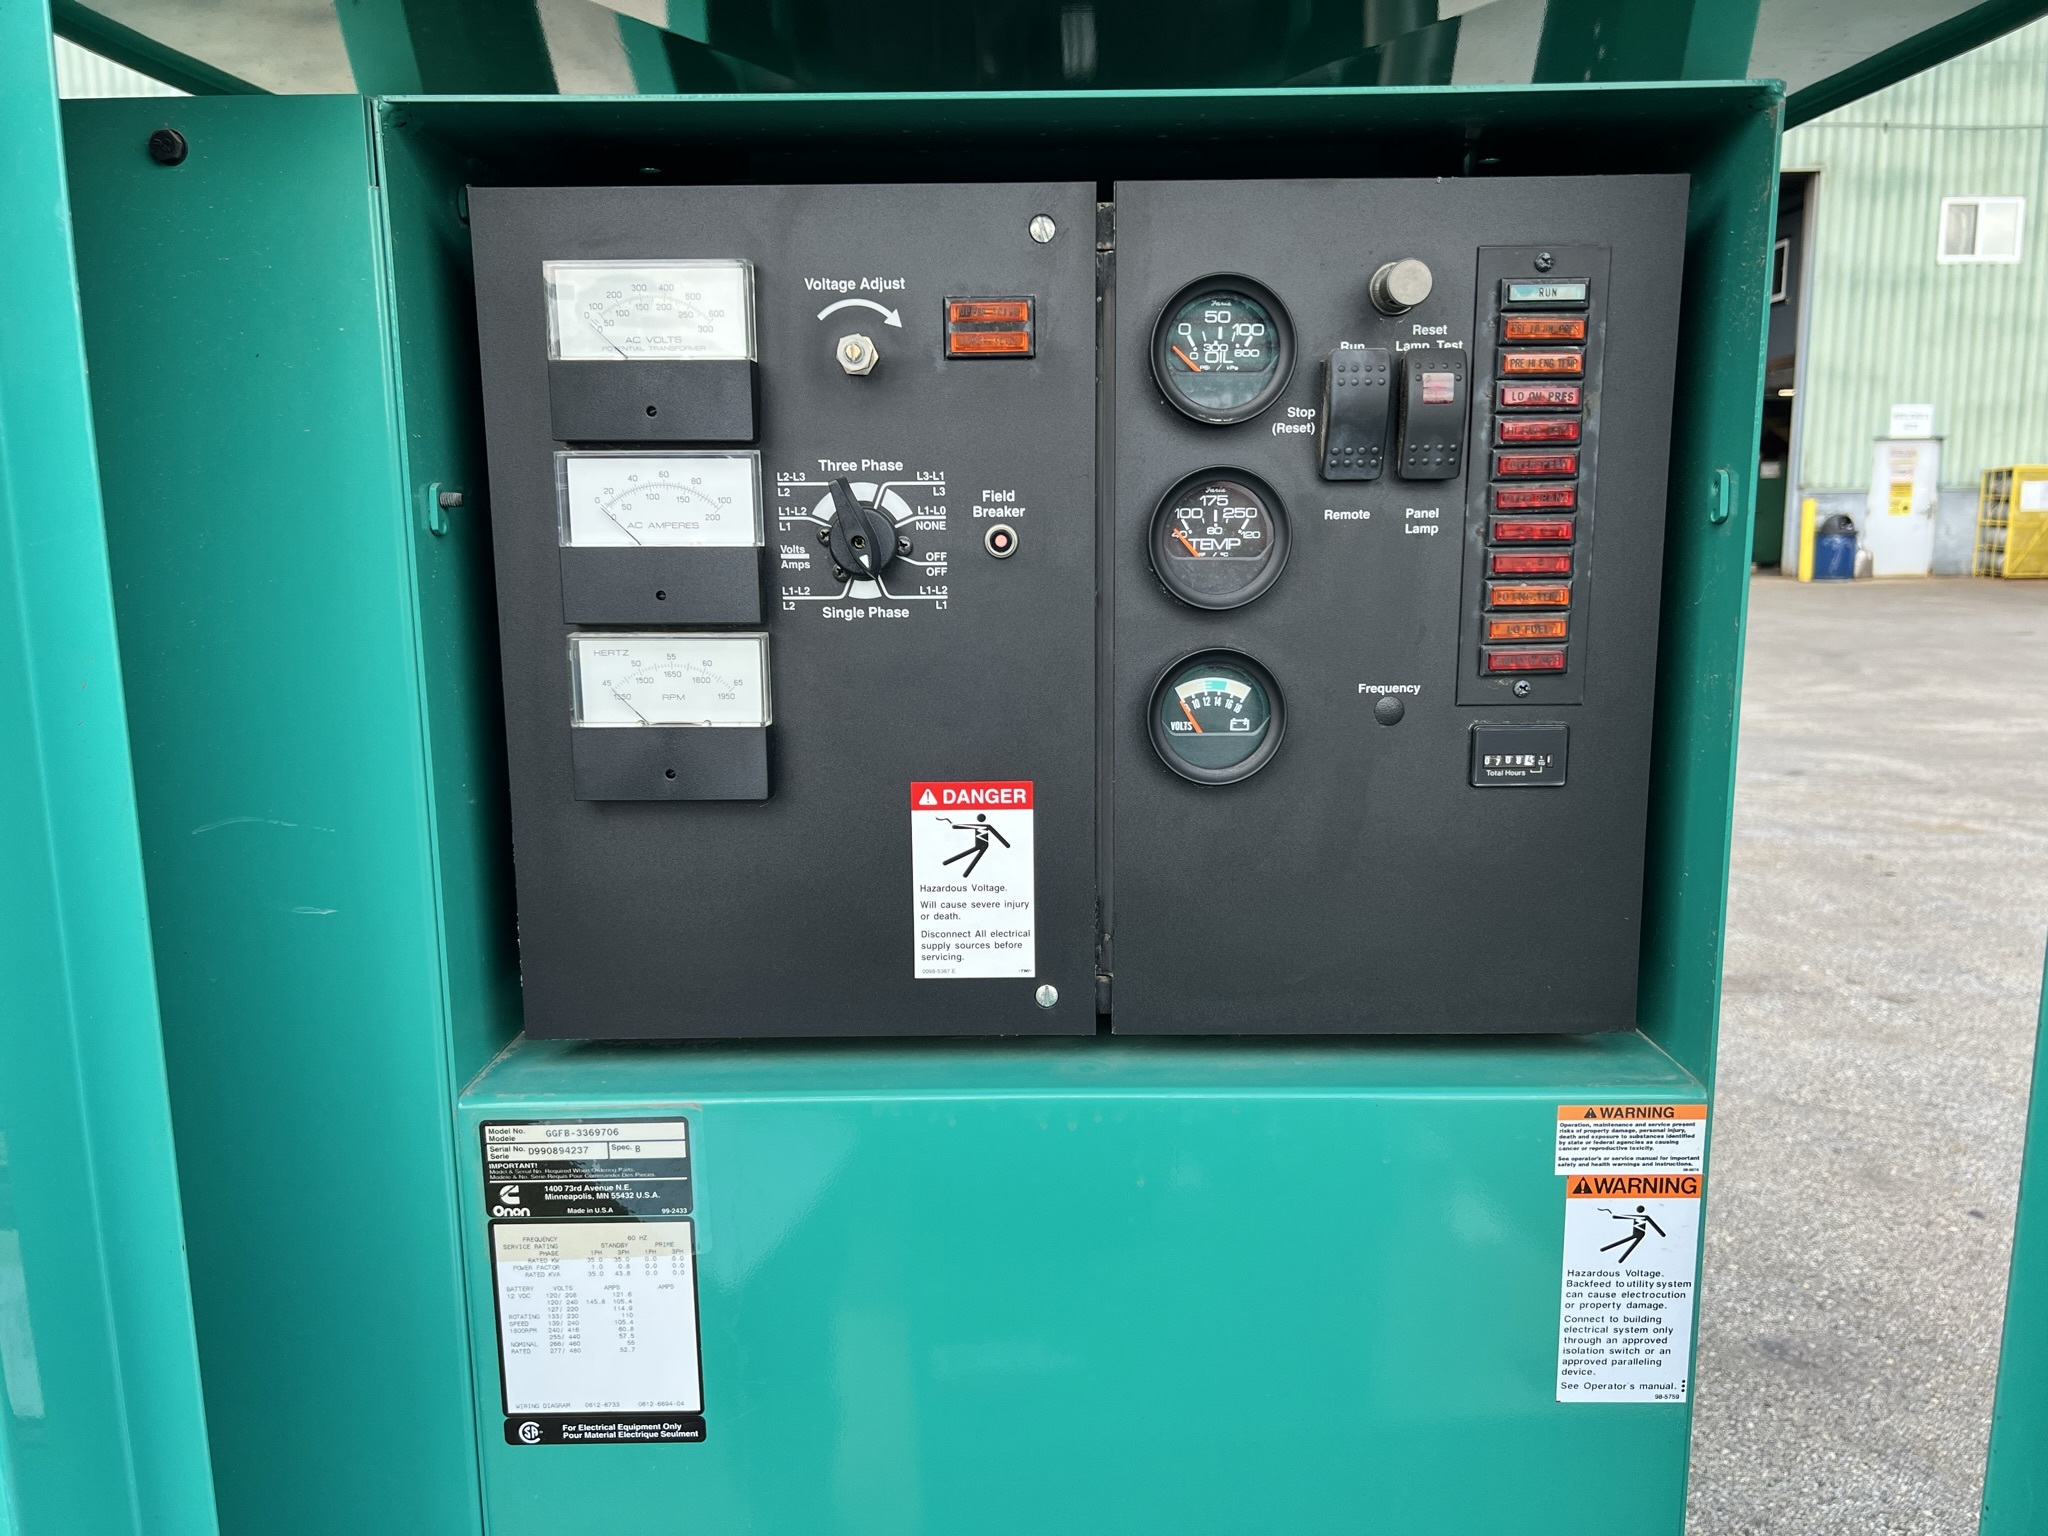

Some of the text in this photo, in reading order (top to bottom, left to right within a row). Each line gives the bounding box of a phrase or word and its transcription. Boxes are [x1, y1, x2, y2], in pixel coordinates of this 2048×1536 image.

[804, 277, 905, 293] Voltage Adjust
[606, 291, 622, 299] 200
[1539, 288, 1557, 297] RUN
[1204, 310, 1231, 323] 50
[1178, 323, 1191, 335] 0
[1232, 324, 1264, 336] 100
[1413, 325, 1448, 335] Reset
[625, 336, 641, 344] AC
[1396, 340, 1463, 351] Lamp Test
[1205, 352, 1233, 363] OIL
[1234, 349, 1260, 357] 600
[1510, 359, 1524, 368] PRE
[1538, 359, 1554, 367] ENG
[1558, 359, 1578, 367] TEMP
[1512, 392, 1524, 401] LO
[1548, 392, 1574, 401] PRES
[1287, 407, 1316, 419] Stop
[1272, 422, 1316, 436] (Reset)
[818, 459, 903, 471] Three Phase
[777, 472, 805, 482] L2-L3
[917, 471, 944, 480] L3-L1
[777, 488, 790, 496] L2
[933, 487, 945, 496] L3
[982, 490, 1015, 502] Field
[1200, 495, 1228, 506] 175
[779, 507, 807, 515] L1-L2
[918, 506, 946, 515] L1-L0
[972, 505, 1025, 517] Breaker
[1174, 508, 1203, 518] 100
[1223, 508, 1257, 518] 250
[1324, 510, 1370, 520] Remote
[1406, 508, 1439, 518] Panel
[779, 522, 790, 531] L1
[916, 521, 946, 530] NONE
[1405, 524, 1439, 536] Lamp
[1188, 538, 1241, 550] TEMP
[780, 545, 805, 554] Volts
[926, 552, 947, 561] OFF
[781, 560, 810, 571] Amps
[926, 568, 947, 576] OFF
[782, 587, 810, 595] L1-L2
[920, 586, 948, 595] L1-L2
[783, 602, 795, 610] L2
[936, 601, 947, 610] L1
[822, 606, 909, 621] Single Phase
[1507, 624, 1549, 633] LO FUEL
[1358, 684, 1420, 695] Frequency
[1192, 699, 1200, 709] 10
[1202, 697, 1210, 706] 12
[1214, 696, 1221, 706] 14
[1225, 699, 1234, 709] 16
[1171, 722, 1192, 730] VOLTS
[943, 789, 1026, 804] DANGER
[971, 884, 1007, 893] Voltage.
[1004, 900, 1029, 909] injury
[921, 930, 971, 938] Disconnect
[921, 942, 951, 951] supply
[994, 941, 1023, 949] before
[921, 953, 964, 962] servicing.
[1600, 1107, 1675, 1118] WARNING
[545, 1128, 619, 1138] GGFB-3369706
[528, 1147, 589, 1155] D990894237
[1594, 1177, 1697, 1194] WARNING
[544, 1193, 595, 1201] Minneapolis,
[493, 1206, 530, 1217] Onan
[1625, 1270, 1664, 1278] Voltage.
[1627, 1281, 1654, 1289] utility
[1656, 1281, 1692, 1289] system
[1579, 1302, 1622, 1310] property
[1626, 1302, 1667, 1310] damage.
[562, 1424, 577, 1432] For
[618, 1423, 661, 1432] Equipment
[663, 1423, 682, 1432] Only
